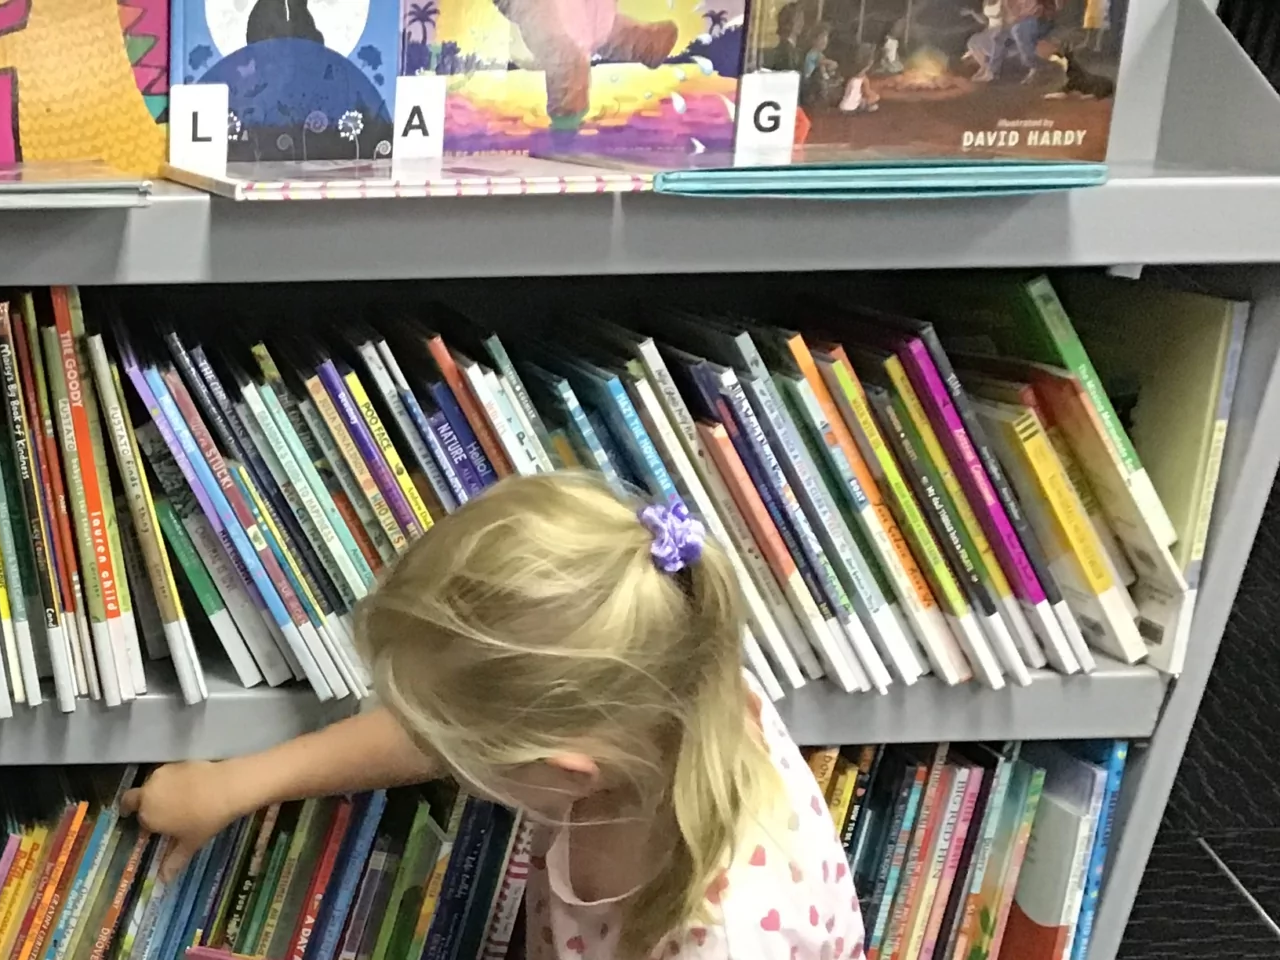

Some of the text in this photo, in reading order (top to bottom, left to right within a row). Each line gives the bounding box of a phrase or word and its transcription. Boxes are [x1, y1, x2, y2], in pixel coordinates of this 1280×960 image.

[191, 112, 211, 142] L
[402, 105, 429, 137] A
[752, 101, 781, 131] G
[962, 129, 1087, 147] DAVID HARDY
[58, 330, 83, 407] THE GOODY
[0, 343, 31, 479] Maisy's Big Book of Kindness
[360, 401, 392, 451] POO FACE
[204, 447, 234, 489] STUCK!
[464, 440, 492, 477] Hello!
[629, 418, 646, 438] THE
[639, 437, 660, 467] MOVIE
[654, 466, 672, 490] STAR
[124, 459, 140, 487] finds
[847, 478, 867, 503] BOAT
[297, 484, 311, 498] TO
[304, 496, 336, 542] HAPPINESS
[369, 492, 405, 544] WHO LIVES
[89, 510, 118, 611] lauren child
[846, 822, 855, 831] TO
[849, 804, 861, 820] HOW
[930, 779, 968, 880] BIG RED HEN
[843, 832, 851, 841] BE
[295, 914, 314, 952] A DAY
